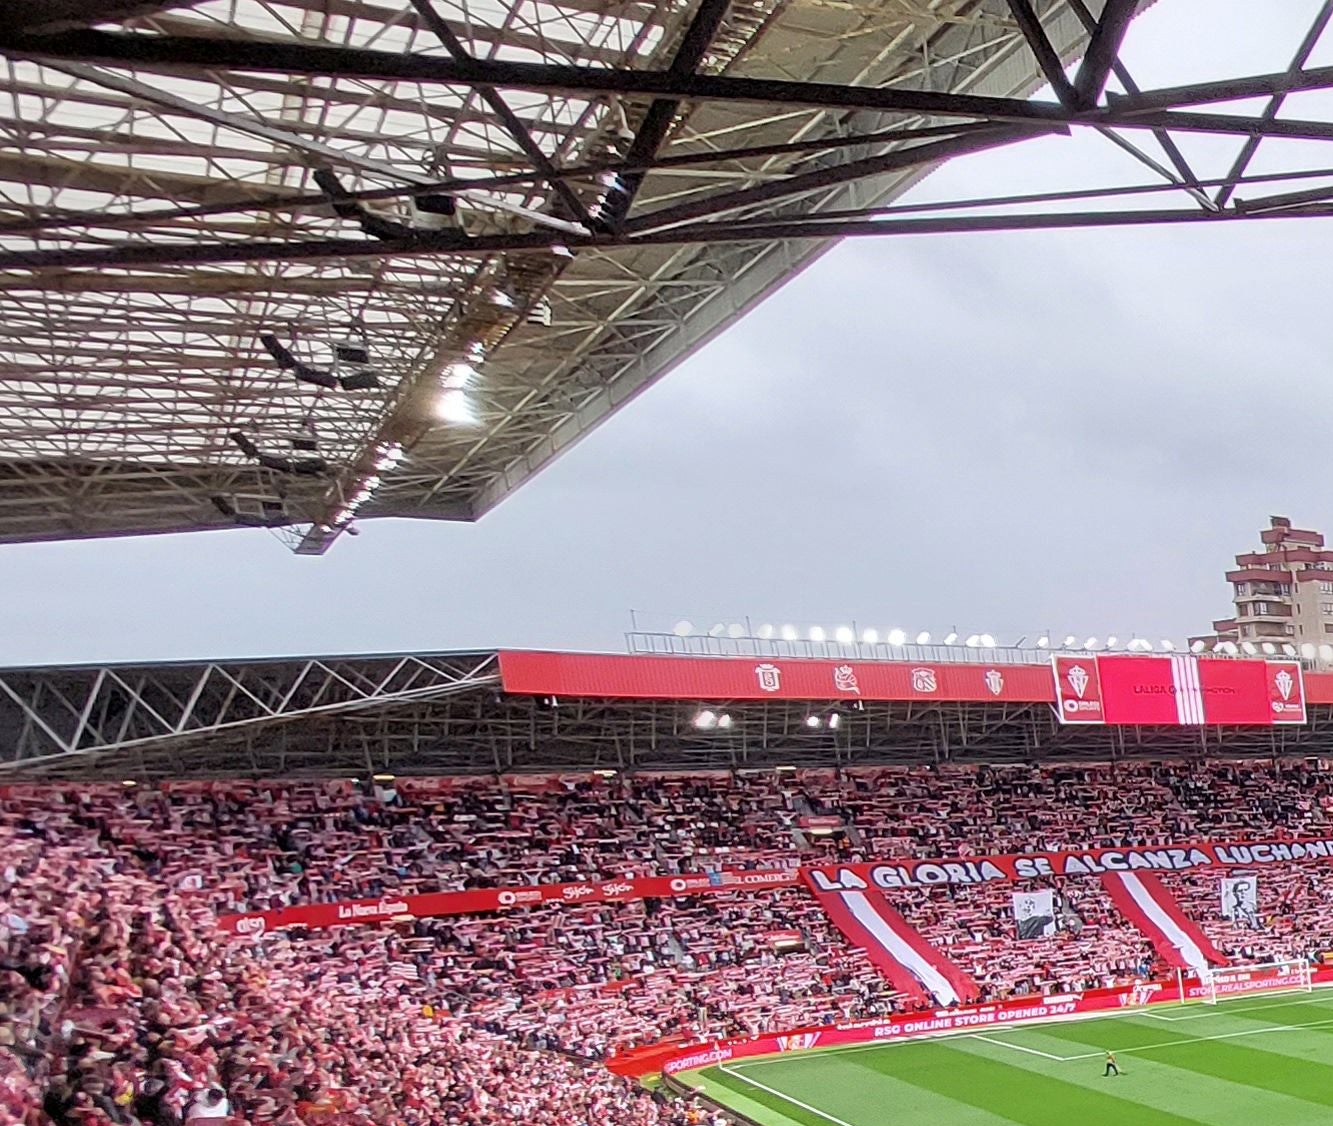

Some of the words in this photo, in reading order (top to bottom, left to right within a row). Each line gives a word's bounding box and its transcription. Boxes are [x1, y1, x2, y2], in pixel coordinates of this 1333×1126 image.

[810, 867, 869, 891] LA
[871, 859, 1008, 889] GLORIA
[1014, 856, 1054, 878] SE
[1064, 847, 1213, 875] ALCANZA
[904, 1018, 951, 1033] ONLINE
[954, 1012, 995, 1027] STORE
[999, 1007, 1048, 1022] OPENED
[1050, 1003, 1077, 1015] 24/7
